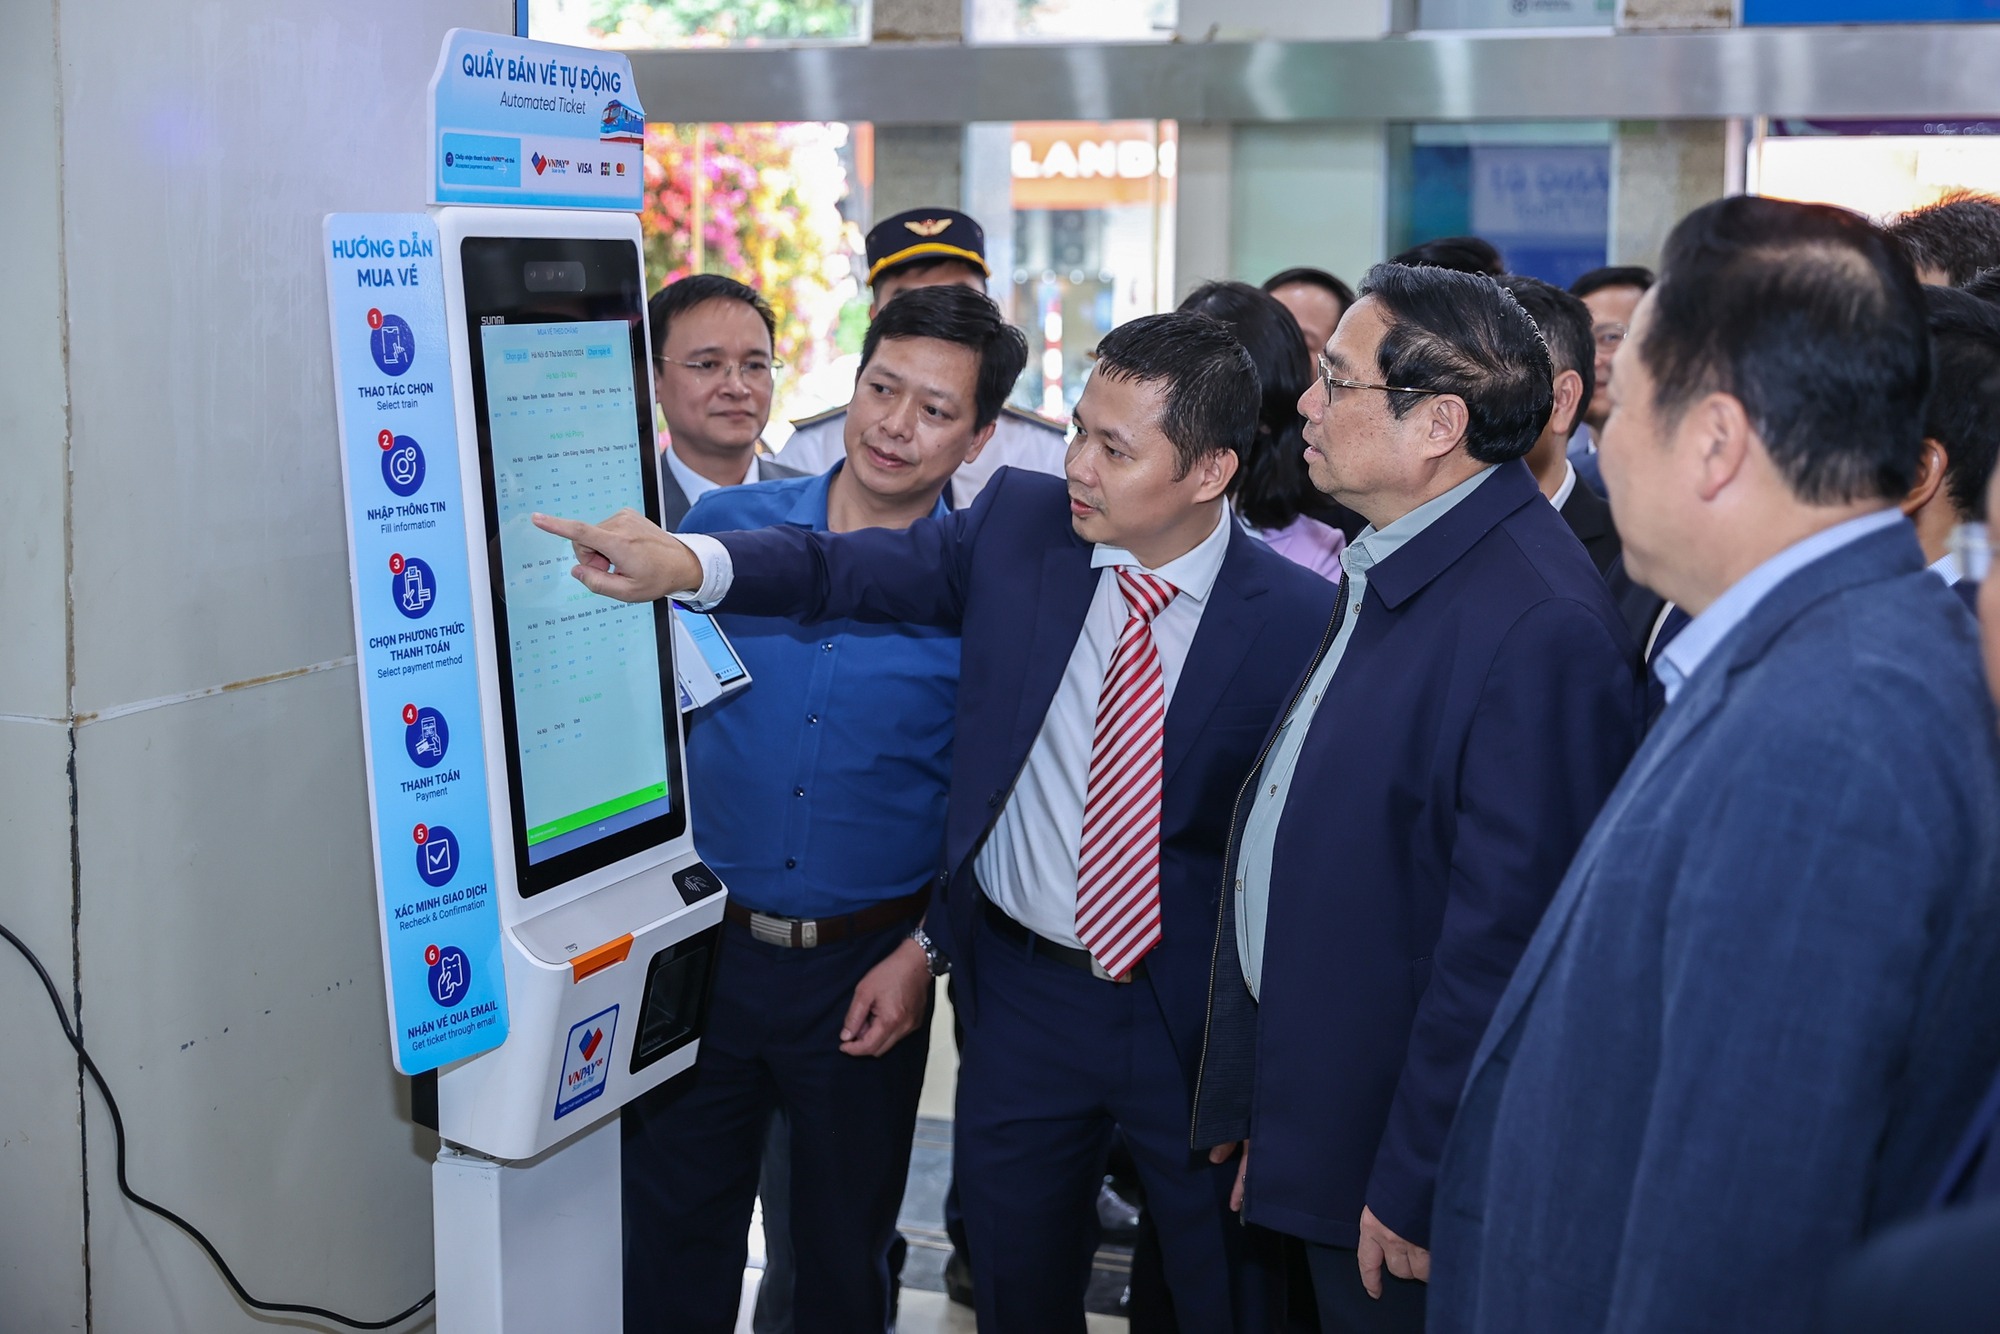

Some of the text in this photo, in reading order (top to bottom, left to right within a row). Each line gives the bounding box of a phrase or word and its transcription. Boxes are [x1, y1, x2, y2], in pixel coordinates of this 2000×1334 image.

[462, 49, 621, 96] QUẦY BÁN VÉ TỰ ĐỘNG
[500, 92, 586, 114] Automated Ticket
[577, 162, 592, 174] VISA
[332, 232, 432, 258] HƯỚNG DẪN
[358, 264, 418, 287] MUA VÉ
[372, 314, 378, 324] 1
[358, 382, 434, 398] THAO TÁC CHỌN
[377, 399, 418, 410] Select train
[382, 434, 389, 446] 2
[368, 501, 446, 521] NHẬP THÔNG TIN
[380, 520, 436, 534] Fill information
[394, 558, 400, 570] 3
[370, 622, 465, 648] CHỌN PHƯƠNG THỨC
[390, 640, 450, 661] THANH TOÁN
[378, 654, 462, 678] Select payment method
[407, 708, 413, 720] 4
[401, 769, 460, 793] THANH TOÁN
[416, 787, 448, 802] Payment
[418, 828, 424, 840] 5
[395, 884, 487, 919] XÁC MINH GIAO DỊCH
[400, 900, 485, 930] Recheck & Confirmation
[429, 950, 435, 960] 6
[408, 1000, 498, 1039] NHẬN VÉ QUA EMAIL
[412, 1015, 496, 1052] Get ticket through email
